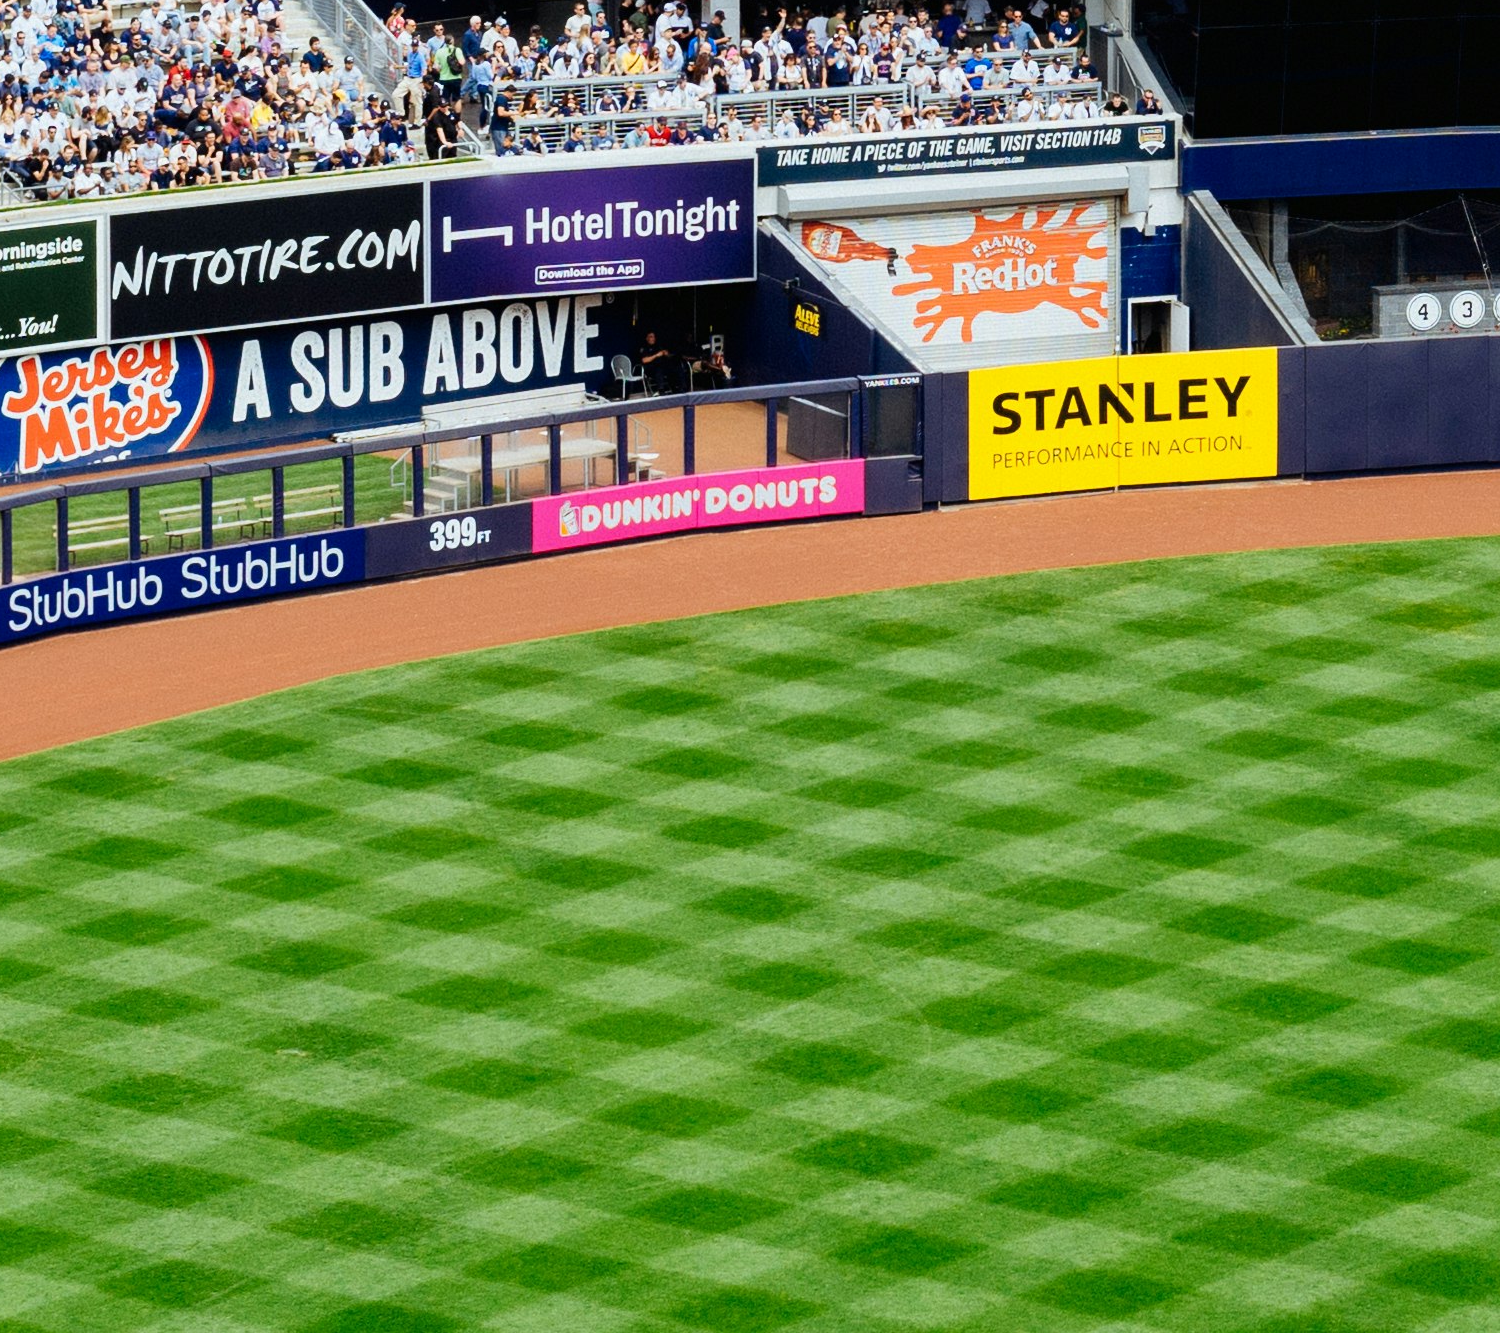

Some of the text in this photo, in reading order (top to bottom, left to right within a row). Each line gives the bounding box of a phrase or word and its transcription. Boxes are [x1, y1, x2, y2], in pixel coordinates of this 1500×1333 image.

[777, 129, 1121, 166] TAKE HOME A PIECE OF THE GAME, VISIT SECTION 114B
[972, 236, 1037, 257] FRANK'S
[4, 336, 180, 418] Jersey
[232, 292, 606, 422] A SUB ABOVE
[18, 385, 181, 474] Mike's
[992, 375, 1250, 436] STANLEY
[992, 435, 1242, 469] PERFORMANCE IN ACTION
[581, 475, 838, 533] DUNKIN' DONUTS
[8, 566, 162, 631] StubHub
[181, 538, 344, 601] StubHub
